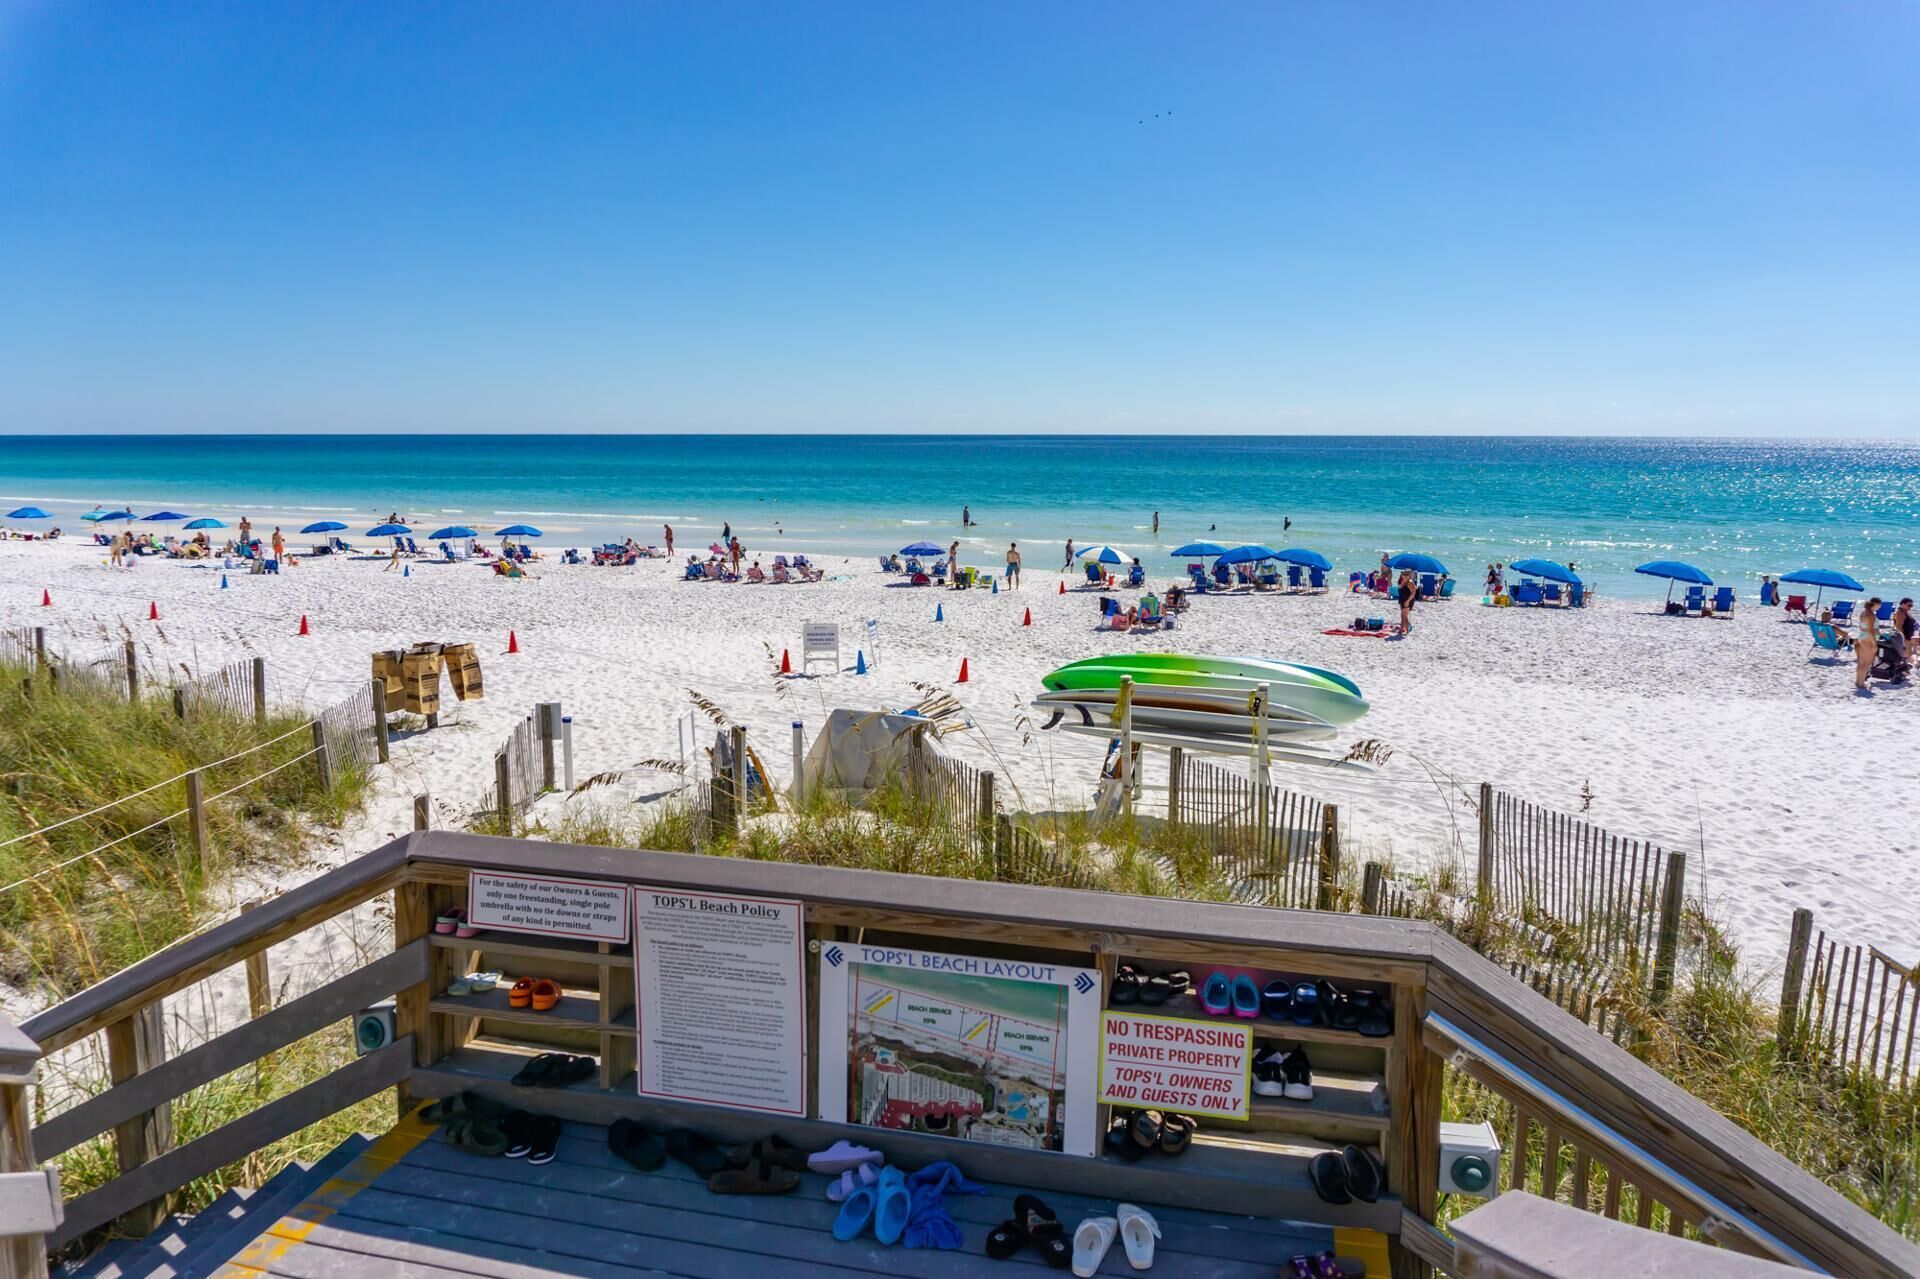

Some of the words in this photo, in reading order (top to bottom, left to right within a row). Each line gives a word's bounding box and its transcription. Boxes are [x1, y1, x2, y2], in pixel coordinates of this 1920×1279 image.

[479, 878, 490, 886] For
[493, 878, 505, 887] the
[506, 881, 528, 891] safety
[530, 883, 538, 891] of
[553, 885, 582, 896] Owners
[592, 890, 620, 900] Guests,
[486, 890, 502, 900] only
[504, 892, 517, 900] one
[569, 899, 592, 909] single
[593, 901, 611, 910] pole
[480, 901, 514, 911] umbrella
[515, 904, 532, 913] with
[544, 907, 555, 915] tie
[556, 909, 581, 918] downs
[592, 913, 617, 922] straps
[652, 894, 698, 910] TOPS'L
[700, 901, 738, 914] Beach
[741, 904, 781, 919] Policy
[502, 914, 510, 922] of
[511, 916, 525, 924] any
[526, 915, 543, 925] kind
[544, 917, 551, 926] is
[552, 919, 592, 931] permitted.
[860, 948, 917, 966] TOPS'L
[922, 954, 978, 973] BEACH
[984, 962, 1056, 981] LAYOUT
[929, 1007, 952, 1015] SERVICE
[1025, 1034, 1049, 1042] SERVICE
[1107, 1020, 1128, 1036] NO
[1134, 1022, 1245, 1048] TRESPASSING
[1109, 1042, 1164, 1061] PRIVATE
[1168, 1049, 1241, 1069] PROPERTY
[1116, 1067, 1164, 1085] TOPS'L
[1169, 1073, 1232, 1093] OWNERS
[1106, 1084, 1137, 1099] AND
[1142, 1087, 1198, 1106] GUESTS
[1201, 1095, 1241, 1111] ONLY
